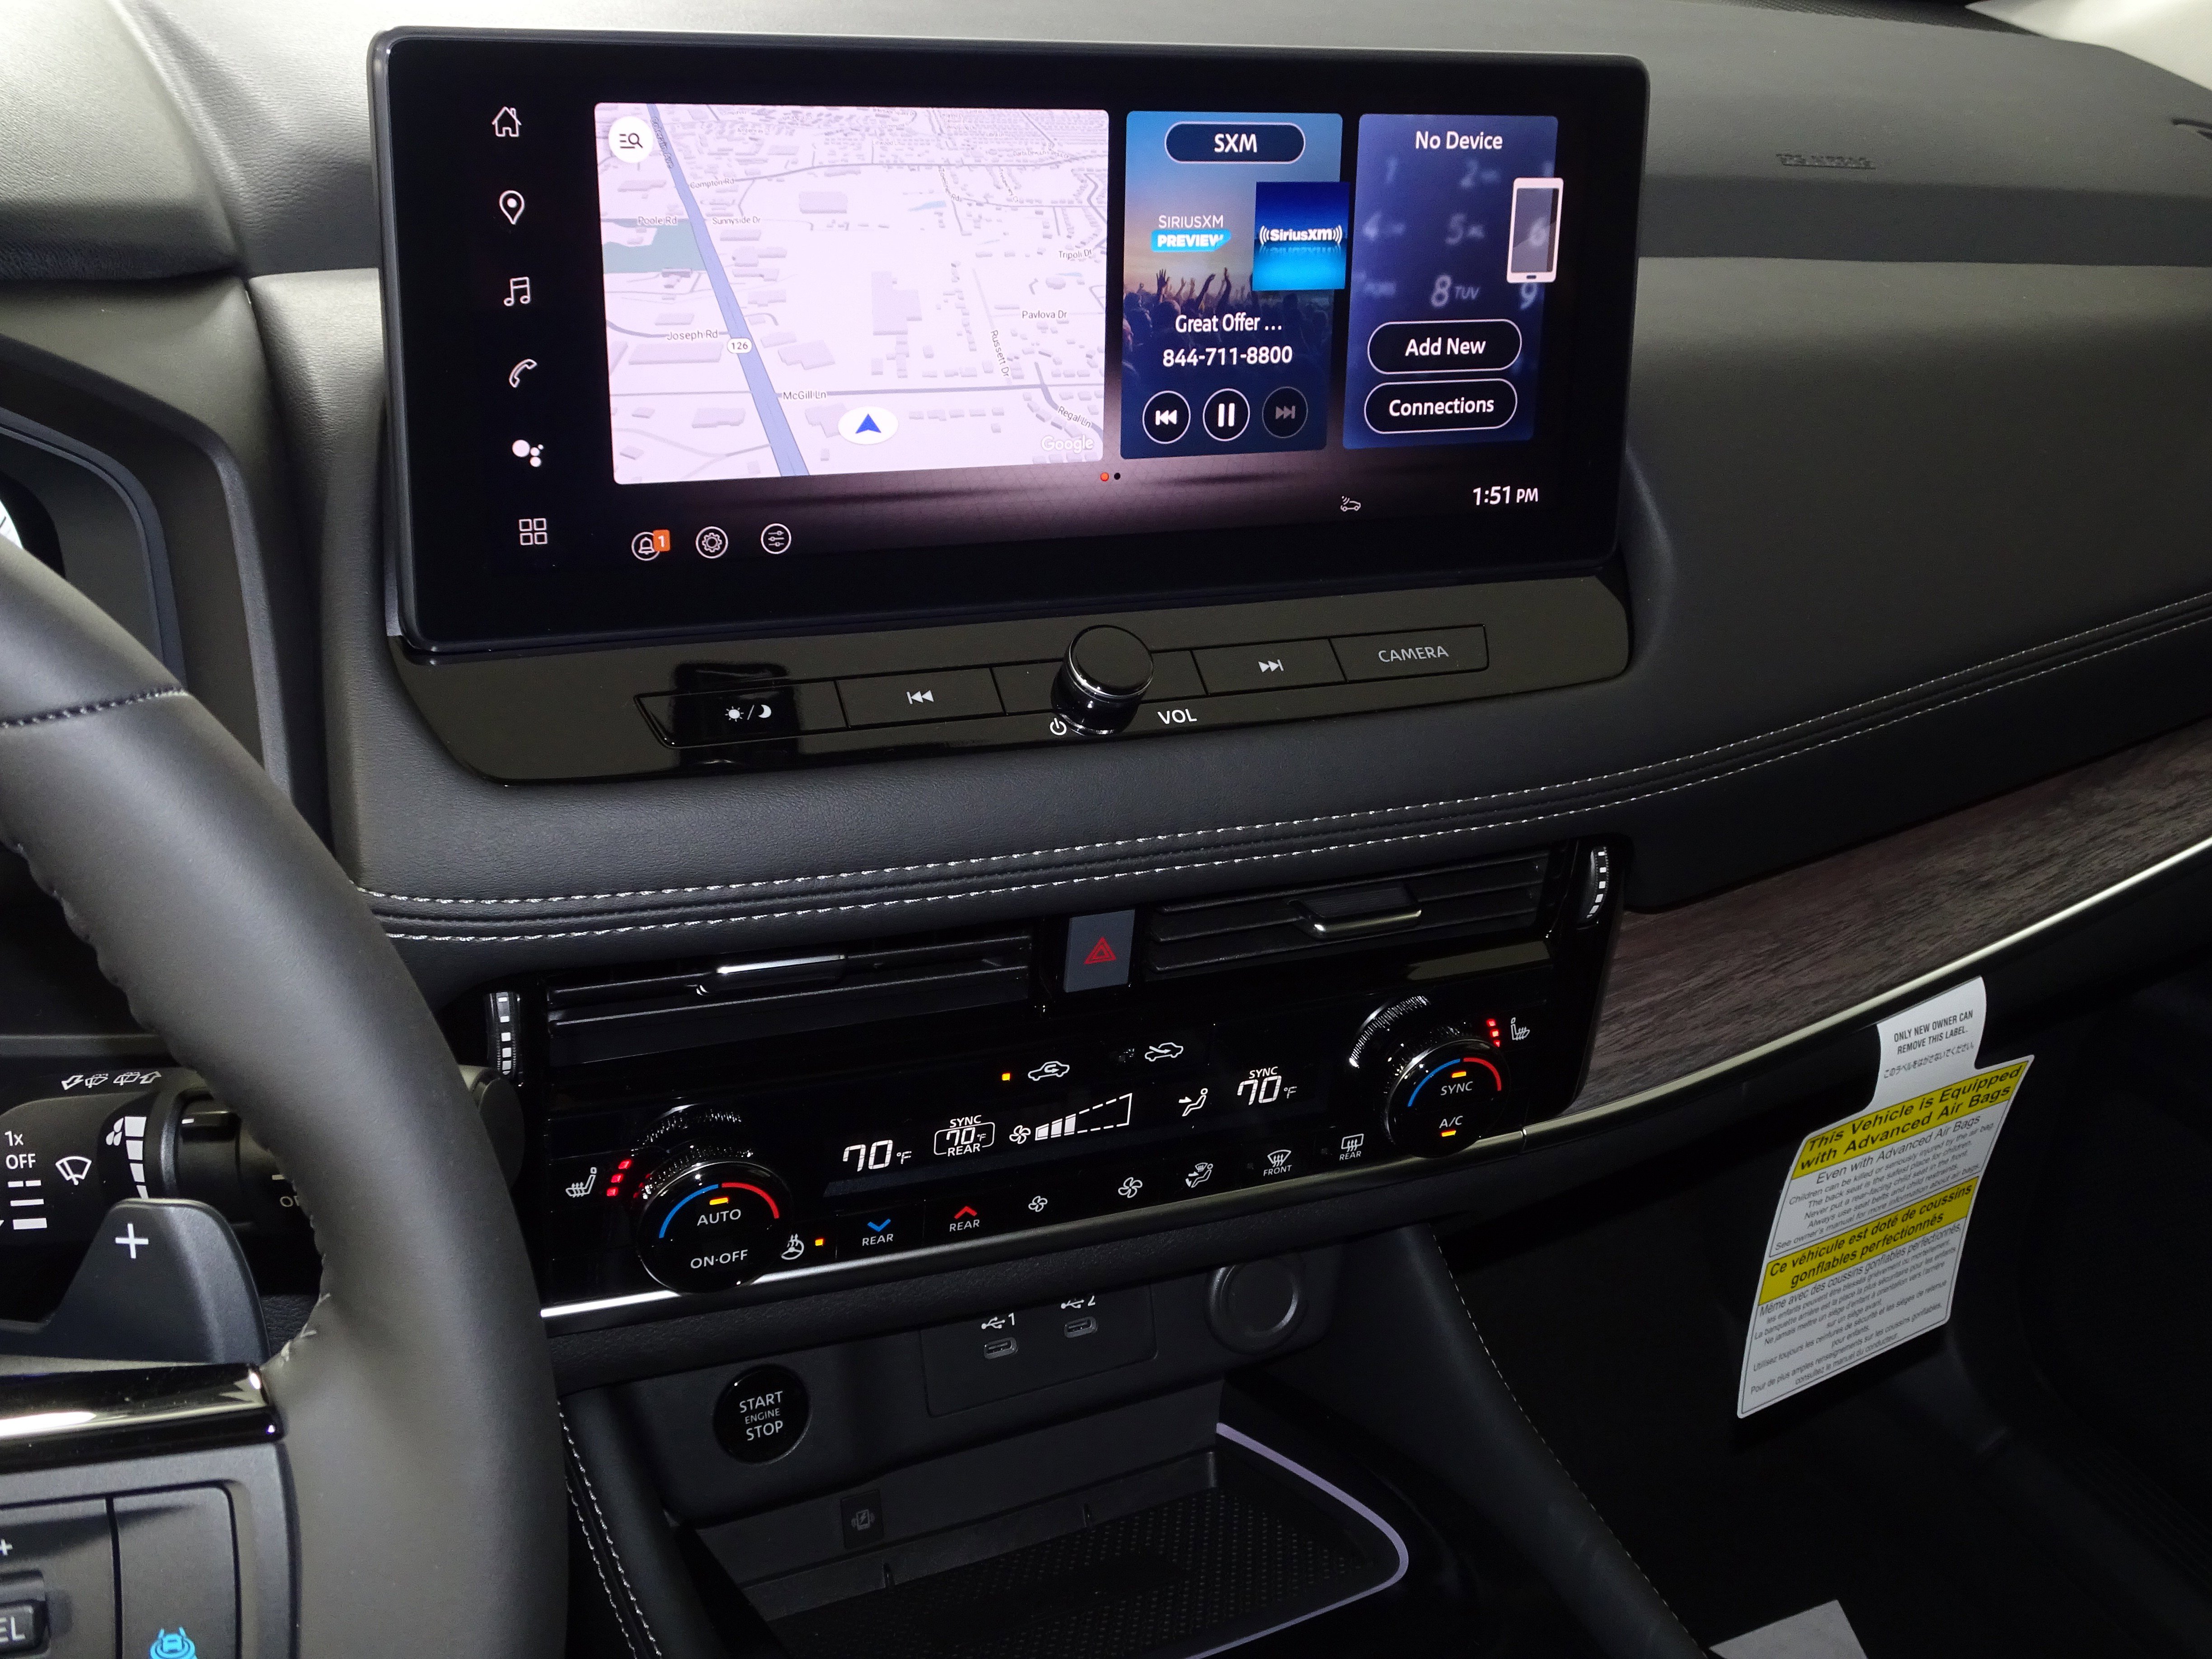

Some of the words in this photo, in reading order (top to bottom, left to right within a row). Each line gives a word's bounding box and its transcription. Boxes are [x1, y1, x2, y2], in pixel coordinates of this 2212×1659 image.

[1214, 133, 1258, 153] SXM
[1415, 131, 1441, 150] No
[1446, 131, 1503, 150] Device
[690, 179, 722, 189] Compton
[637, 216, 663, 225] Poole
[665, 216, 677, 224] Rd
[712, 216, 751, 225] Sunnyside
[1158, 215, 1224, 228] SIRIUSXM
[1157, 234, 1224, 248] PREVIEW
[1059, 251, 1081, 260] Tripoli
[1083, 249, 1092, 257] Dr
[1430, 274, 1453, 309] 8
[1022, 310, 1055, 319] Pavlova
[1058, 310, 1068, 319] Dr
[1175, 314, 1218, 333] Great
[1222, 312, 1261, 331] Offer
[667, 330, 703, 341] Joseph
[705, 329, 719, 339] Rd
[731, 342, 748, 350] 126
[991, 329, 1006, 365] Russett
[1001, 366, 1009, 378] Dr
[1405, 337, 1442, 356] Add
[1447, 337, 1486, 355] New
[1162, 346, 1293, 367] 844-711-8800
[783, 391, 813, 400] McGill
[815, 391, 827, 399] Ln
[1058, 406, 1081, 423] Regal
[1082, 417, 1092, 427] Ln
[1388, 398, 1495, 417] Connections
[1041, 435, 1094, 453] Google
[1472, 486, 1511, 506] 1:51
[1516, 488, 1539, 502] PM
[658, 535, 665, 548] 1
[1377, 645, 1449, 664] CAMERA
[1157, 708, 1198, 725] VOL
[1894, 1028, 1912, 1042] ONLY
[1914, 1023, 1930, 1036] NEW
[1932, 1015, 1957, 1030] OWNER
[1959, 1009, 1973, 1022] CAN
[1897, 1038, 1926, 1055] REMOVE
[1928, 1033, 1943, 1045] THIS
[1945, 1026, 1968, 1039] LABEL.
[1249, 1066, 1278, 1079] SYNC
[1440, 1081, 1473, 1096] SYNC
[1809, 1130, 1844, 1151] This
[1852, 1105, 1914, 1134] Vehicle
[1919, 1097, 1934, 1110] is
[1939, 1062, 2023, 1102] Equipped
[949, 1115, 982, 1128] SYNC
[1439, 1115, 1463, 1129] A/C
[1801, 1148, 1837, 1170] with
[1844, 1111, 1933, 1154] Advanced
[1937, 1102, 1963, 1120] Air
[1968, 1086, 2010, 1108] Bags
[5, 1130, 24, 1147] 1x
[947, 1143, 981, 1157] REAR
[1339, 1150, 1362, 1161] REAR
[1816, 1167, 1847, 1184] Even
[1851, 1156, 1873, 1172] with
[1876, 1132, 1933, 1162] Advanced
[1934, 1127, 1950, 1140] Air
[1952, 1115, 1980, 1132] Bags
[5, 1153, 36, 1169] OFF
[1263, 1164, 1293, 1176] FRONT
[1789, 1189, 1823, 1205] Children
[1824, 1183, 1840, 1192] can
[1841, 1178, 1851, 1187] be
[1853, 1169, 1874, 1181] killed
[1875, 1166, 1884, 1174] or
[1808, 1199, 1823, 1208] The
[1825, 1190, 1843, 1203] back
[1846, 1183, 1863, 1195] seat
[1872, 1176, 1885, 1185] the
[697, 1208, 741, 1226] AUTO
[1804, 1206, 1828, 1219] Never
[1829, 1200, 1843, 1211] put
[1807, 1214, 1836, 1228] Always
[1837, 1208, 1852, 1218] use
[1853, 1199, 1870, 1212] seat
[949, 1219, 980, 1233] REAR
[1770, 1262, 1787, 1276] Ce
[1792, 1239, 1845, 1267] véhicule
[1848, 1228, 1868, 1245] est
[1871, 1214, 1898, 1235] doté
[1901, 1209, 1916, 1223] de
[1919, 1185, 1972, 1214] coussins
[1775, 1240, 1792, 1251] See
[1793, 1228, 1824, 1243] owner's
[1826, 1214, 1855, 1231] manual
[862, 1233, 894, 1247] REAR
[1791, 1250, 1857, 1289] gonflables
[1860, 1213, 1943, 1259] perfectionnés
[1760, 1299, 1786, 1316] Même
[1788, 1289, 1809, 1305] avec
[1810, 1282, 1826, 1295] des
[1827, 1266, 1863, 1288] coussins
[1864, 1247, 1906, 1274] gonflables
[1008, 1312, 1015, 1326] 1
[739, 1391, 784, 1413] START
[745, 1407, 781, 1424] ENGINE
[745, 1420, 784, 1441] STOP
